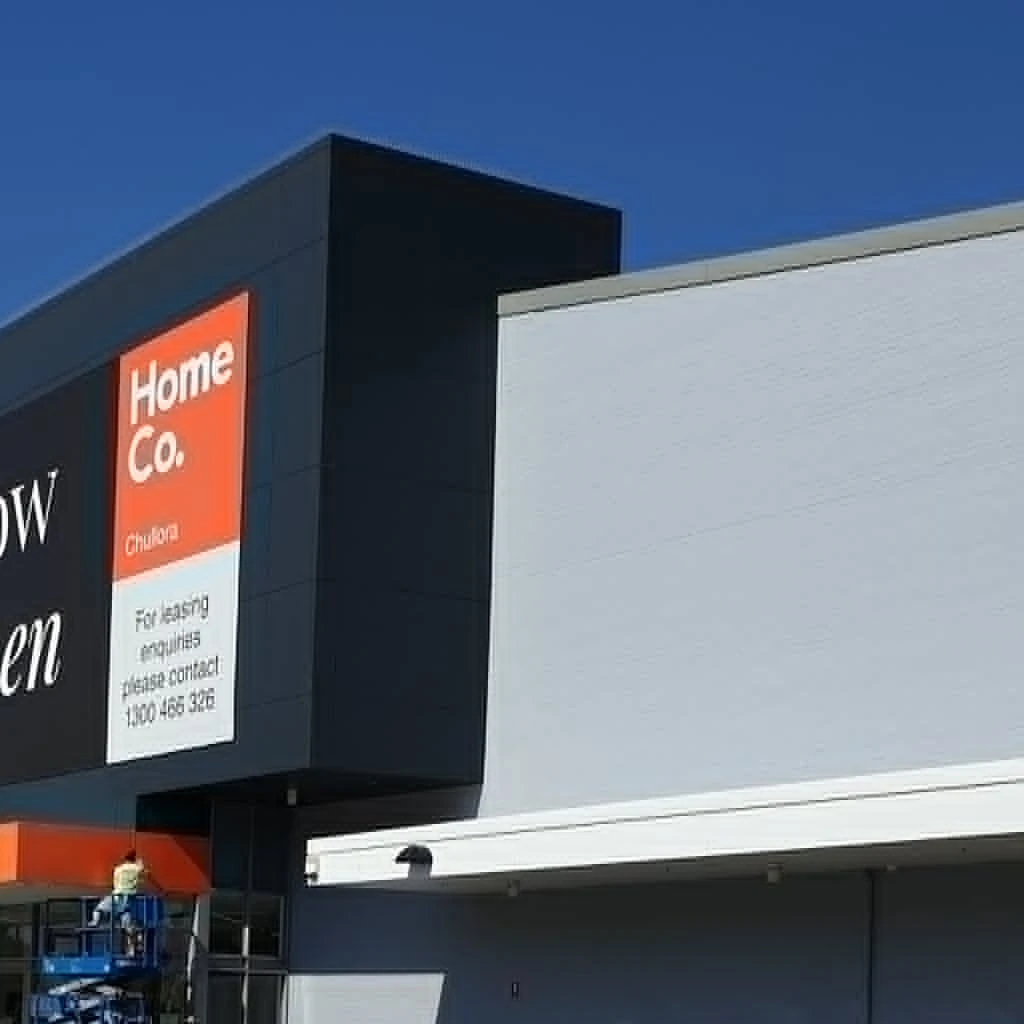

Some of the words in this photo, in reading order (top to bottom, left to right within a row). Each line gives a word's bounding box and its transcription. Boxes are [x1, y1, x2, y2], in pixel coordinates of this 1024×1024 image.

[130, 341, 233, 424] Home
[128, 425, 184, 483] Co.
[125, 524, 179, 556] Chullora
[136, 608, 157, 632] For
[160, 595, 209, 624] leasing
[138, 629, 201, 663] enquiries
[122, 673, 166, 702] please
[168, 655, 219, 687] contact
[126, 702, 157, 728] 1300
[188, 687, 216, 713] 326
